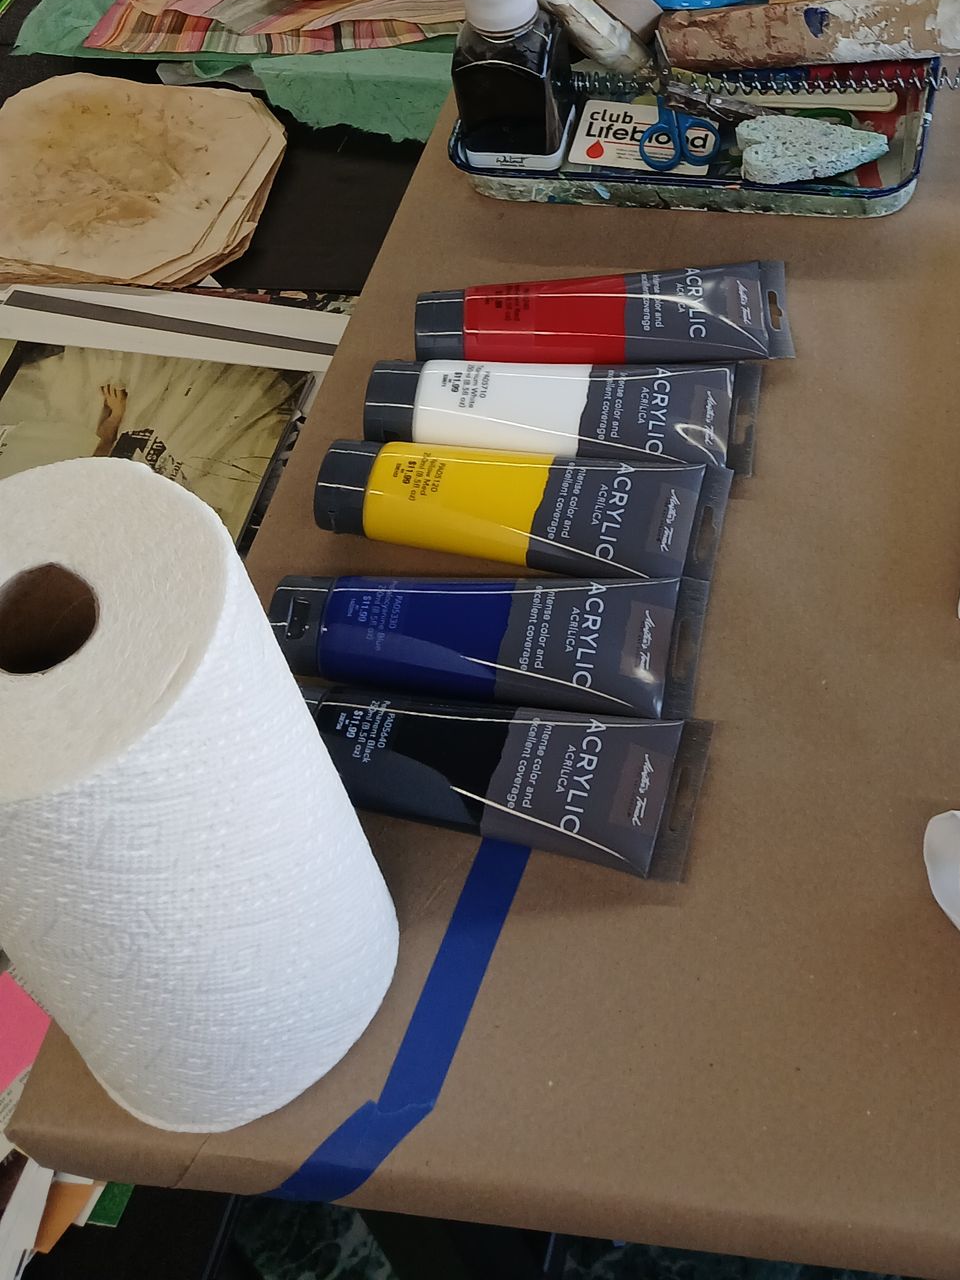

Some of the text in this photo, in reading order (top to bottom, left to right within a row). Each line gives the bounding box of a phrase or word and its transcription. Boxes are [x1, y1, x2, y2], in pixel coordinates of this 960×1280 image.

[589, 108, 634, 125] club
[585, 121, 709, 150] Lifeblod
[684, 267, 707, 339] ACRYLIC
[655, 312, 665, 328] and
[450, 371, 463, 393] $11.99
[468, 387, 479, 409] White
[613, 398, 624, 420] color
[644, 367, 672, 455] ACRYLIC
[596, 401, 610, 441] coverage
[610, 421, 621, 439] and
[402, 461, 417, 485] $11.99
[419, 451, 431, 470] 20ml
[420, 478, 431, 497] Med
[546, 496, 565, 540] coverage
[560, 468, 588, 539] ntense color and
[595, 462, 637, 561] ACRYLIC
[358, 595, 372, 622] $11.99
[374, 584, 387, 605] 20ml
[534, 590, 556, 669] ntense color and
[572, 581, 607, 688] ACRYLIC
[519, 624, 535, 671] coverage
[345, 709, 364, 738] $11.99
[362, 700, 391, 763] Permanent Black
[377, 712, 396, 749] PA05640
[352, 744, 361, 759] oz)
[507, 716, 541, 809] excellent coverage
[530, 757, 542, 785] color
[559, 717, 607, 835] ACRYLIC
[522, 785, 535, 809] and
